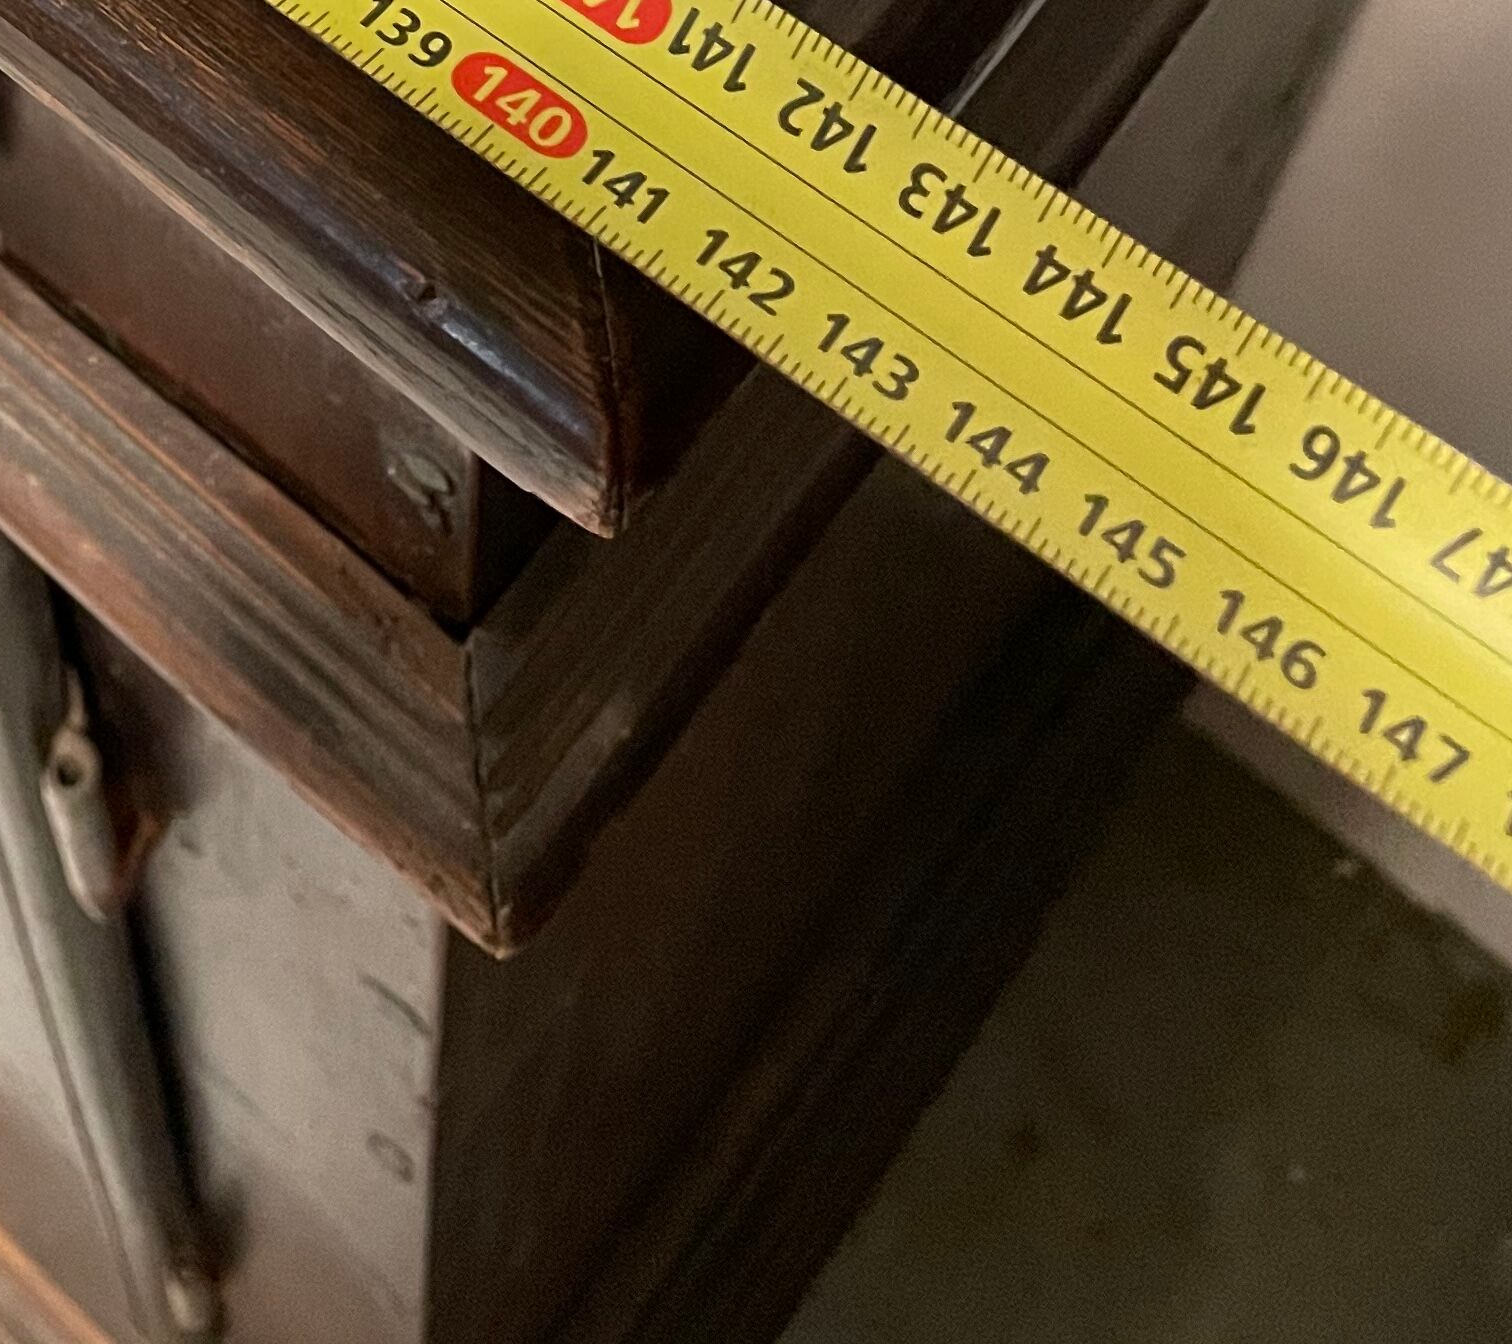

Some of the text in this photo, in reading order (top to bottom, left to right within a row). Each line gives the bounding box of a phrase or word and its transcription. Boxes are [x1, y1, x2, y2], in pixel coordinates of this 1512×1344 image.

[471, 65, 572, 148] 140
[582, 148, 670, 223] 141
[696, 228, 796, 315] 142
[815, 313, 920, 402] 143
[934, 401, 1051, 494] 144
[1074, 493, 1187, 589] 145
[1214, 589, 1328, 690] 146
[1352, 689, 1470, 784] 147
[668, 7, 756, 93] 141
[776, 77, 878, 173] 142
[898, 162, 1003, 258] 143
[1021, 244, 1134, 345] 144
[1153, 334, 1268, 436] 145
[1287, 424, 1408, 530] 146
[1430, 528, 1512, 598] 47
